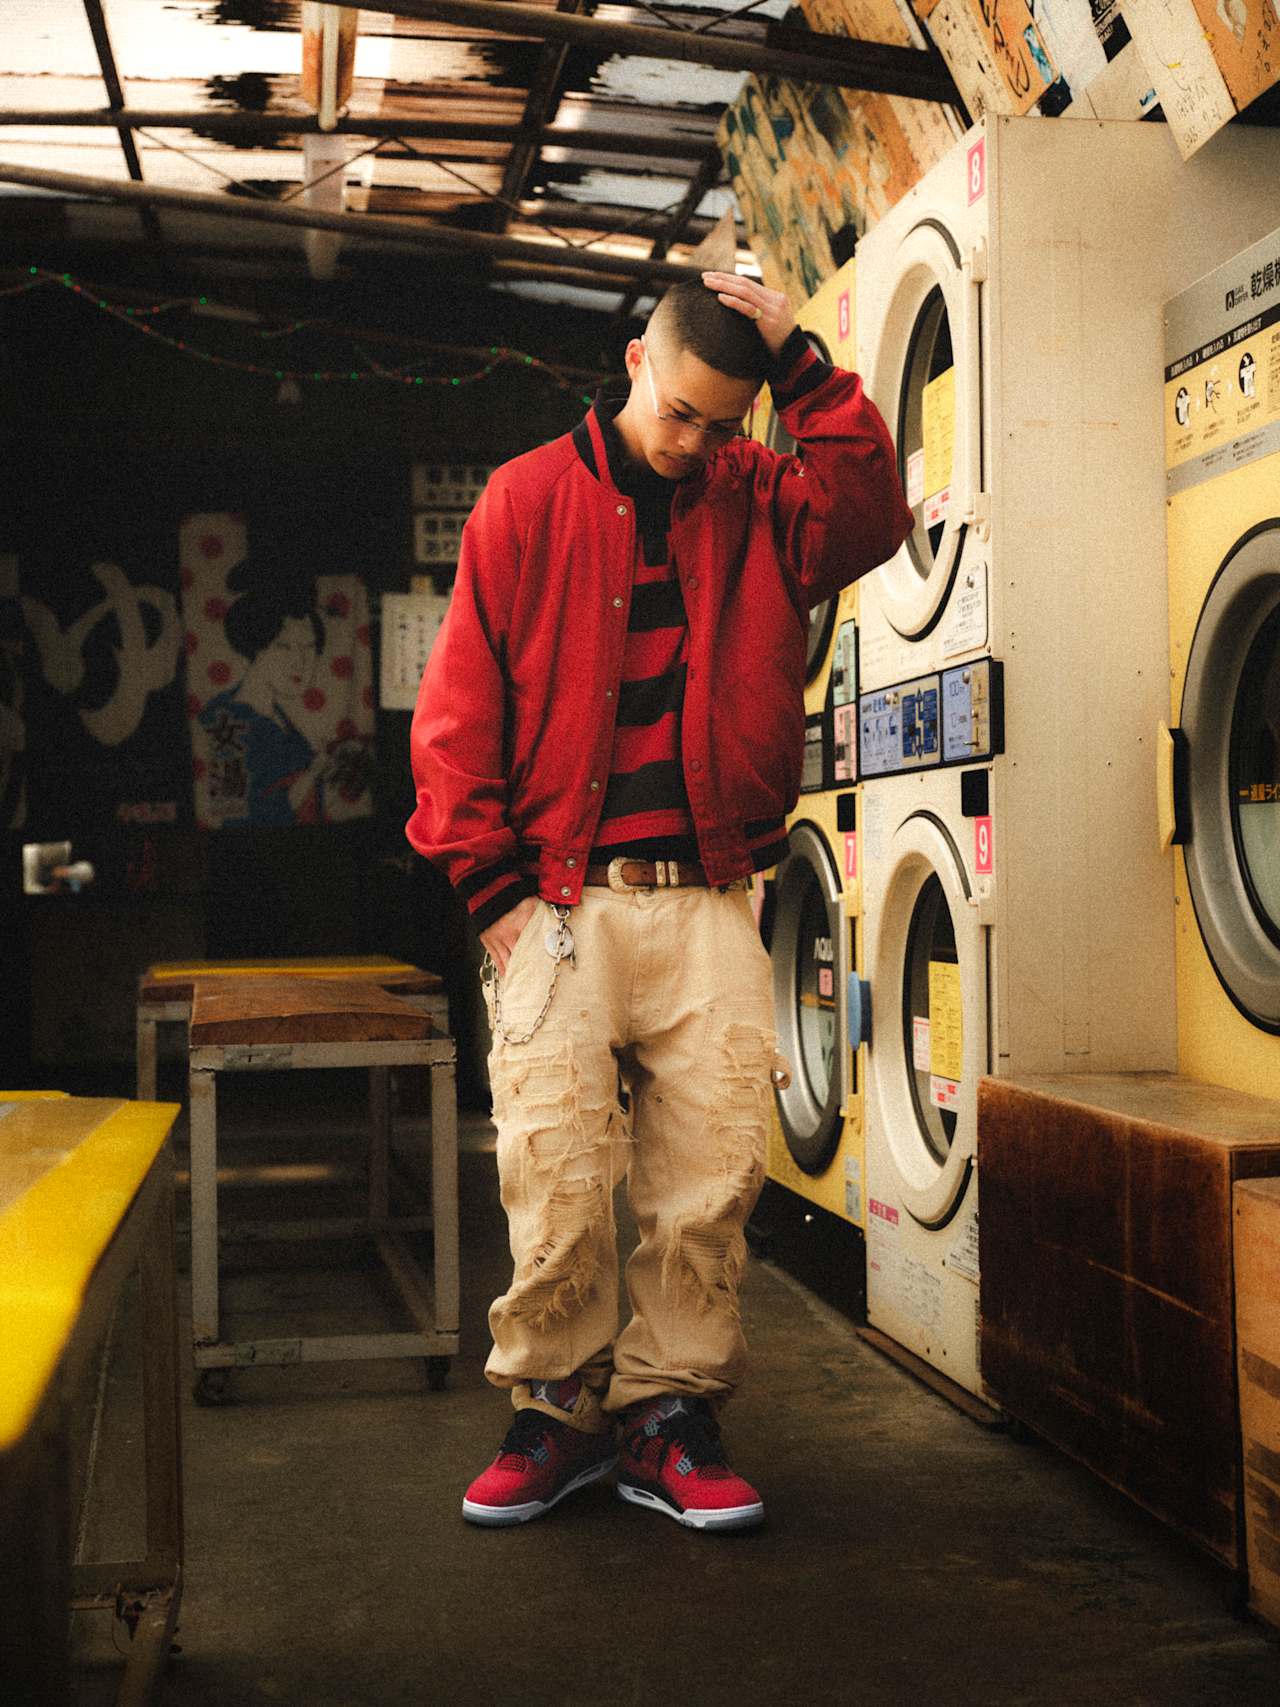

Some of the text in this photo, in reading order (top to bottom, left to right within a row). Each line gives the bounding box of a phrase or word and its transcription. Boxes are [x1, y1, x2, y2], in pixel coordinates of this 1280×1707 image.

[971, 151, 981, 194] 8
[840, 298, 848, 333] 6
[979, 825, 988, 865] 9
